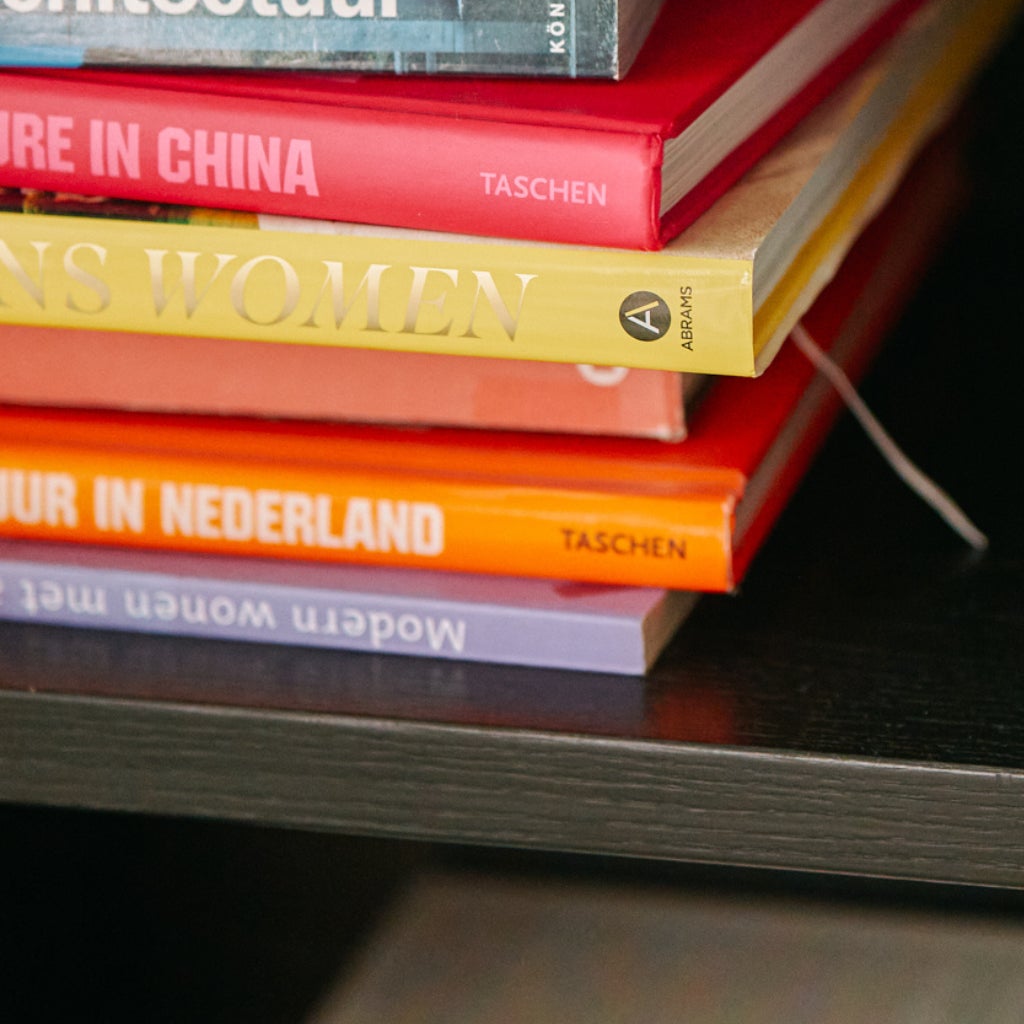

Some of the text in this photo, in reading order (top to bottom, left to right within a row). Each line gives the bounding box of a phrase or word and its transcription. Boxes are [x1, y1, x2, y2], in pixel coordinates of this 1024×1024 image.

[0, 110, 320, 198] RE IN CHINA
[480, 172, 608, 207] TASCHEN
[144, 248, 538, 343] WOMEN
[680, 285, 694, 352] ABRAMS
[0, 468, 445, 556] UR IN NEDERLAND
[561, 529, 687, 560] TASCHEN
[20, 579, 107, 616] met
[124, 588, 276, 631] wonen
[291, 605, 468, 652] Modern
